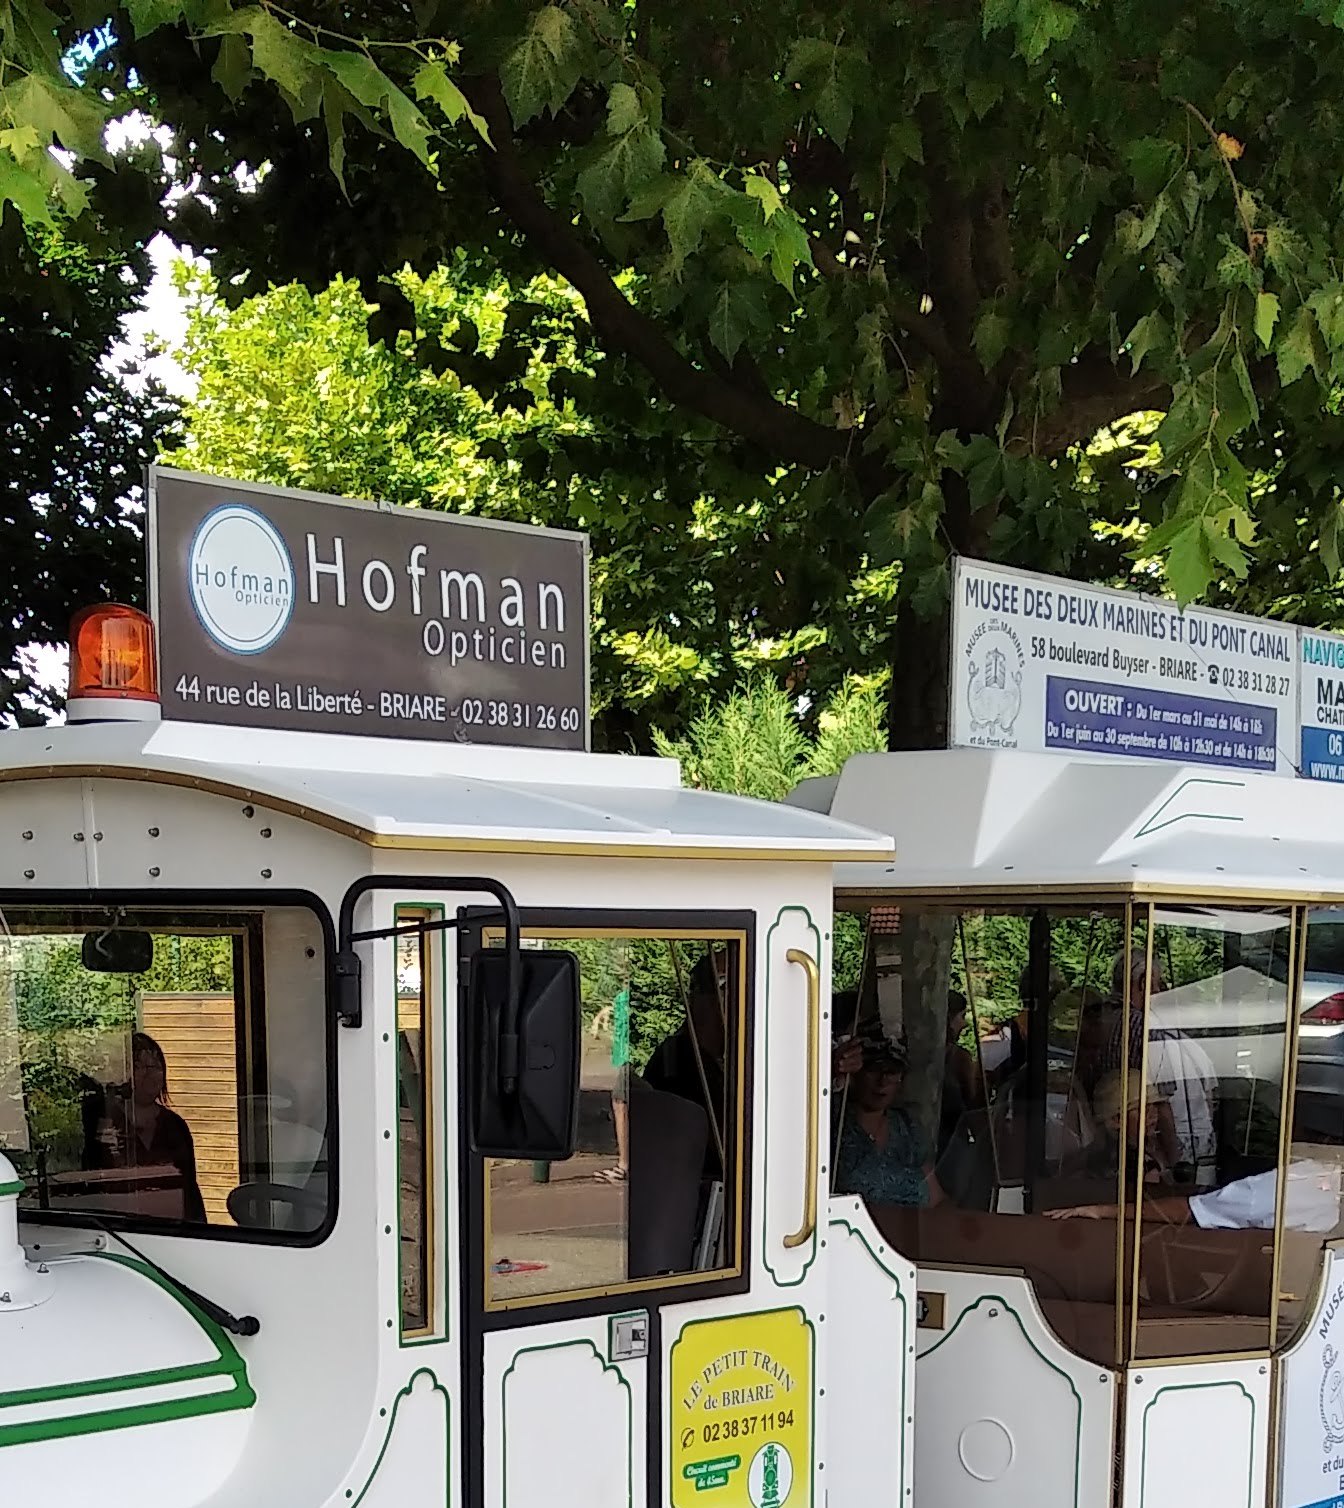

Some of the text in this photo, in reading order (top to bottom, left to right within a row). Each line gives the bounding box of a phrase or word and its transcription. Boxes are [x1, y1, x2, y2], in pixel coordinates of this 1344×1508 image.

[195, 563, 289, 596] Hofman
[305, 533, 565, 632] Hofman
[234, 589, 289, 607] Opticien
[965, 577, 1291, 663] MUSEE DES DEUX MARINES ET DU PONT CANAL
[423, 619, 566, 669] Opticien
[965, 622, 987, 657] MUSEE
[1031, 636, 1290, 696] 58 boulevard Buyser BRIARE 02 38 31 28 27
[175, 674, 579, 732] 44 rue de la Liberté BRIARE 02 38 31 26 60
[1064, 689, 1125, 717] OUVERT
[1136, 705, 1147, 719] Du
[1149, 706, 1161, 721] 1er
[1162, 711, 1181, 724] mars
[1182, 713, 1191, 725] au
[1192, 711, 1203, 726] 31
[1203, 713, 1218, 729] mai
[1218, 715, 1228, 730] de
[1047, 721, 1059, 738] Du
[1061, 723, 1074, 739] 1er
[1075, 725, 1092, 744] juin
[1093, 729, 1104, 742] au
[1105, 728, 1116, 744] 30
[1117, 731, 1156, 749] septembre
[1158, 733, 1168, 749] de
[1169, 734, 1183, 751] 10h
[1328, 733, 1343, 756] 06
[683, 1350, 795, 1411] LE PETIT TRAIN
[703, 1383, 774, 1410] de BRIARE
[703, 1409, 794, 1443] 02 38 37 11 94
[1322, 1462, 1331, 1474] et
[1333, 1455, 1344, 1470] du
